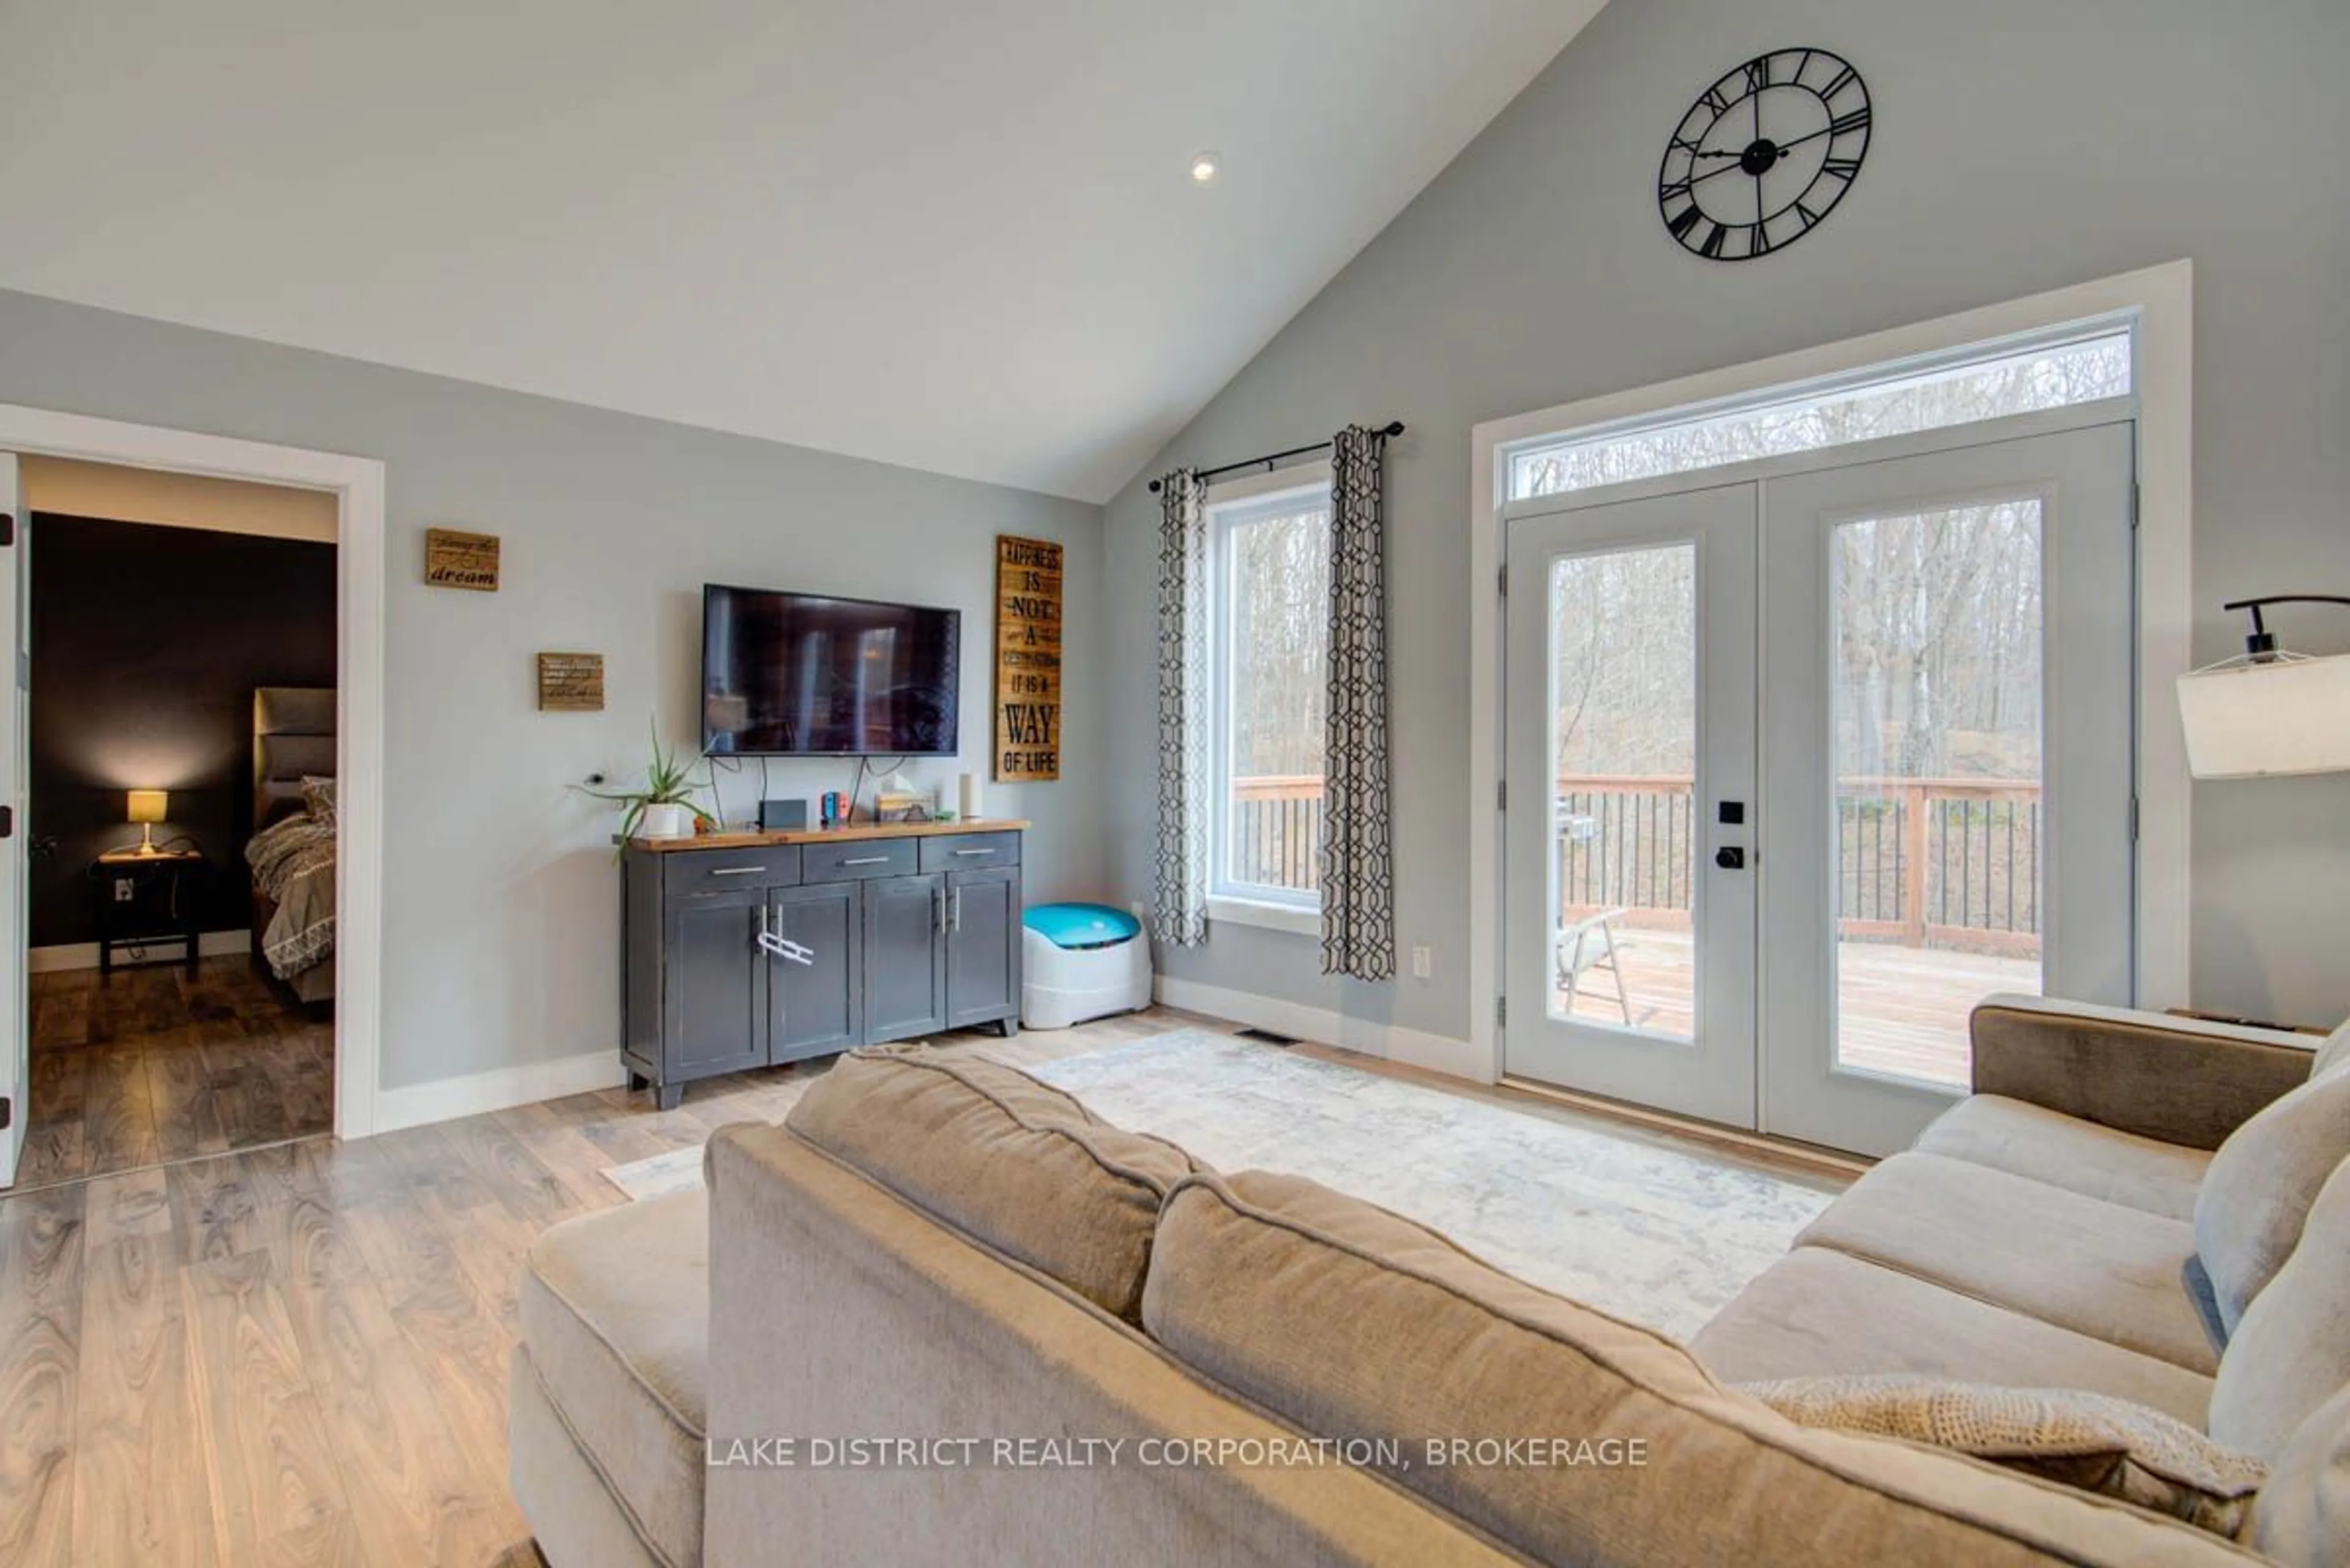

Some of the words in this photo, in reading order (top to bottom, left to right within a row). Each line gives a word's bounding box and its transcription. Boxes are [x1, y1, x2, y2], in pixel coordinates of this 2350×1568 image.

[430, 566, 495, 584] dream
[1024, 570, 1040, 592] IS
[1011, 595, 1054, 620] NOT
[1024, 625, 1037, 646] A
[1011, 673, 1022, 693] IT
[1026, 674, 1037, 693] IS
[1004, 703, 1053, 744] WAY
[1004, 752, 1021, 772] OF
[1025, 752, 1056, 773] LIFE
